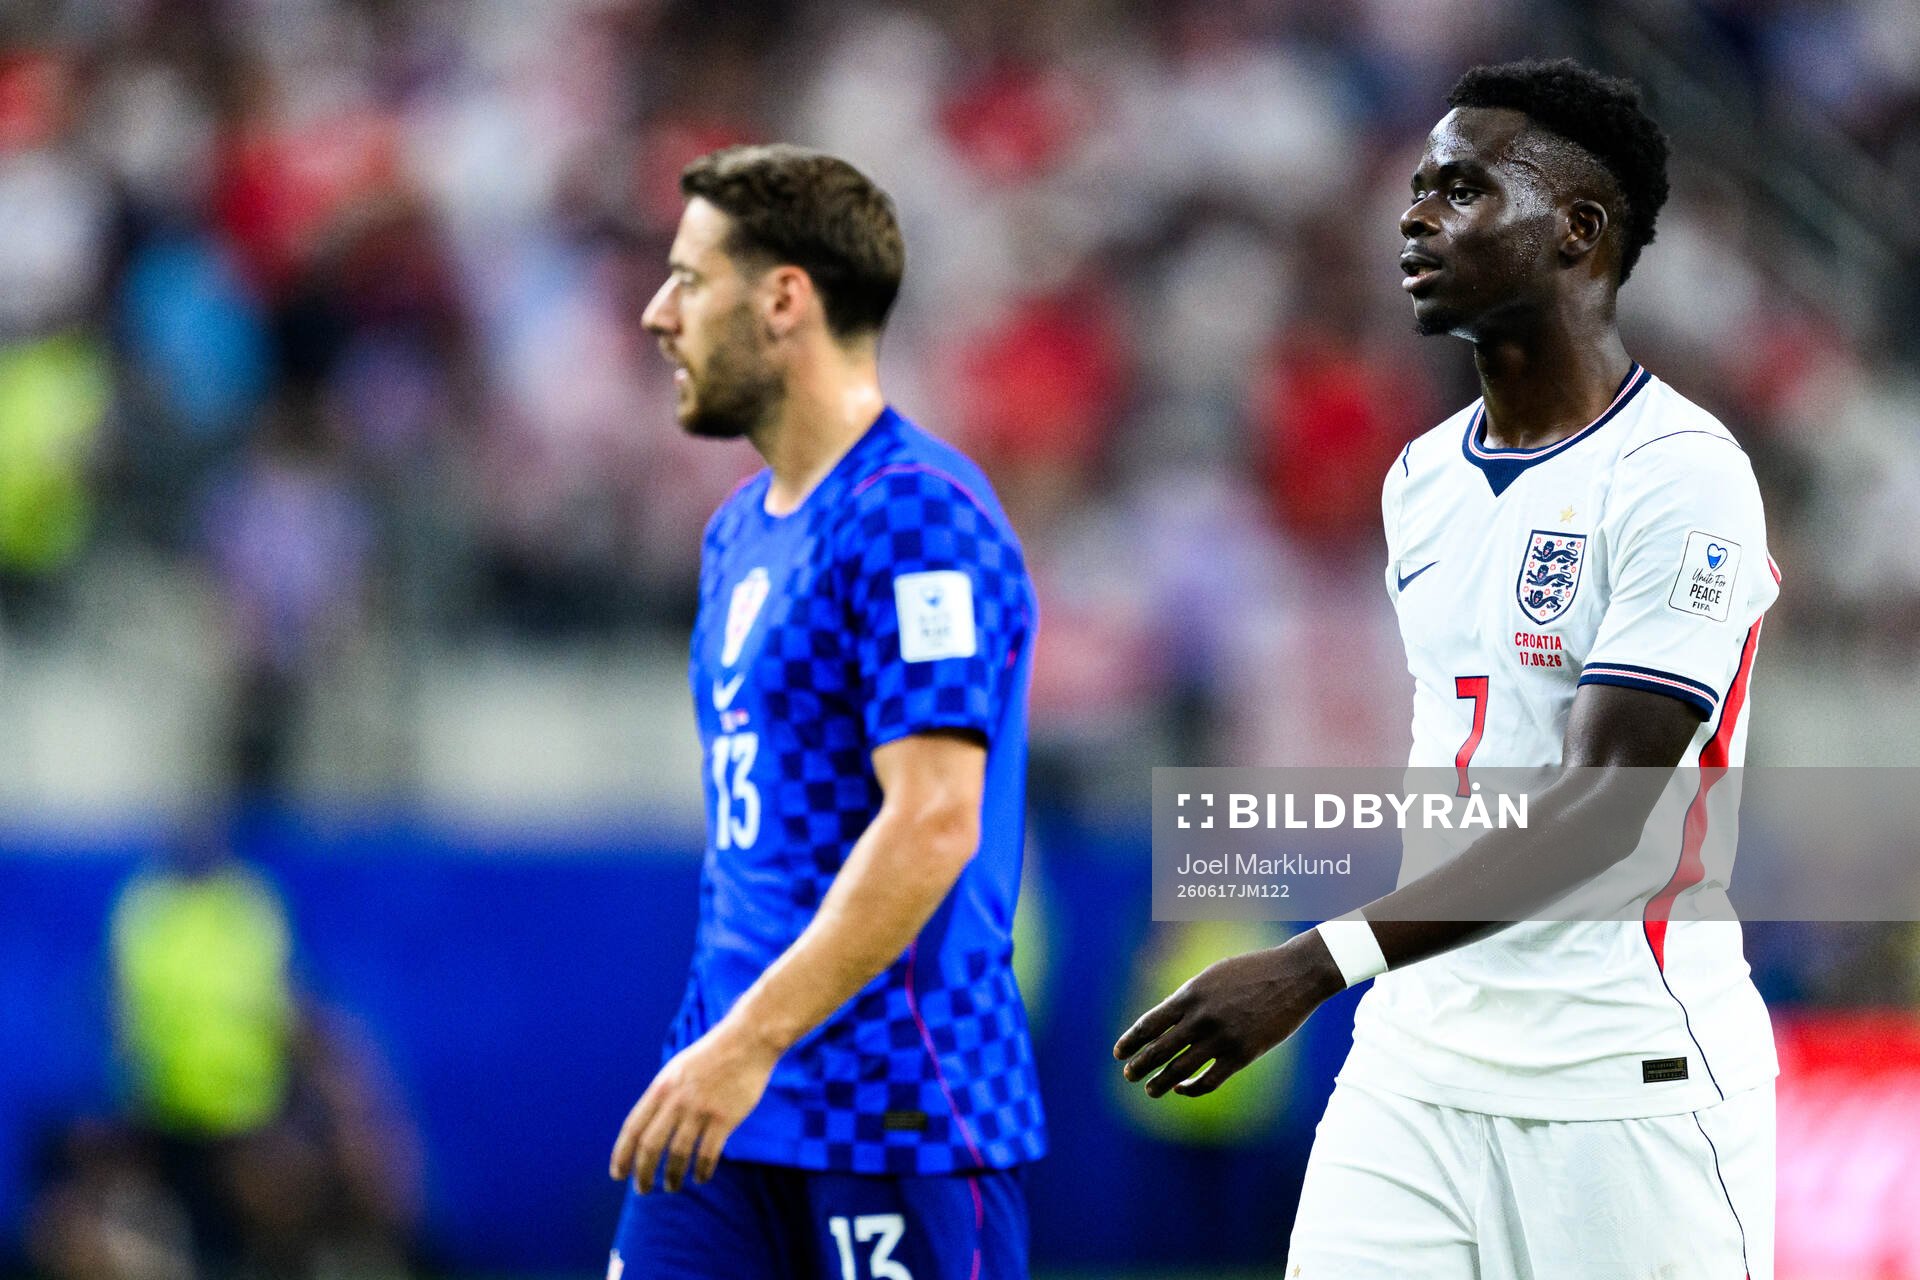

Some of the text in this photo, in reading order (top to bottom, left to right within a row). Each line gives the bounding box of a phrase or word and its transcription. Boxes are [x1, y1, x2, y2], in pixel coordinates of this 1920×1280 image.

[1692, 568, 1713, 584] Unite
[1689, 583, 1722, 604] PEACE
[1692, 601, 1711, 612] FIFA
[1515, 632, 1562, 650] CROATIA
[1520, 652, 1562, 667] 17.06.26
[1455, 675, 1489, 798] 7
[712, 731, 761, 850] 13
[829, 1213, 914, 1280] 13
